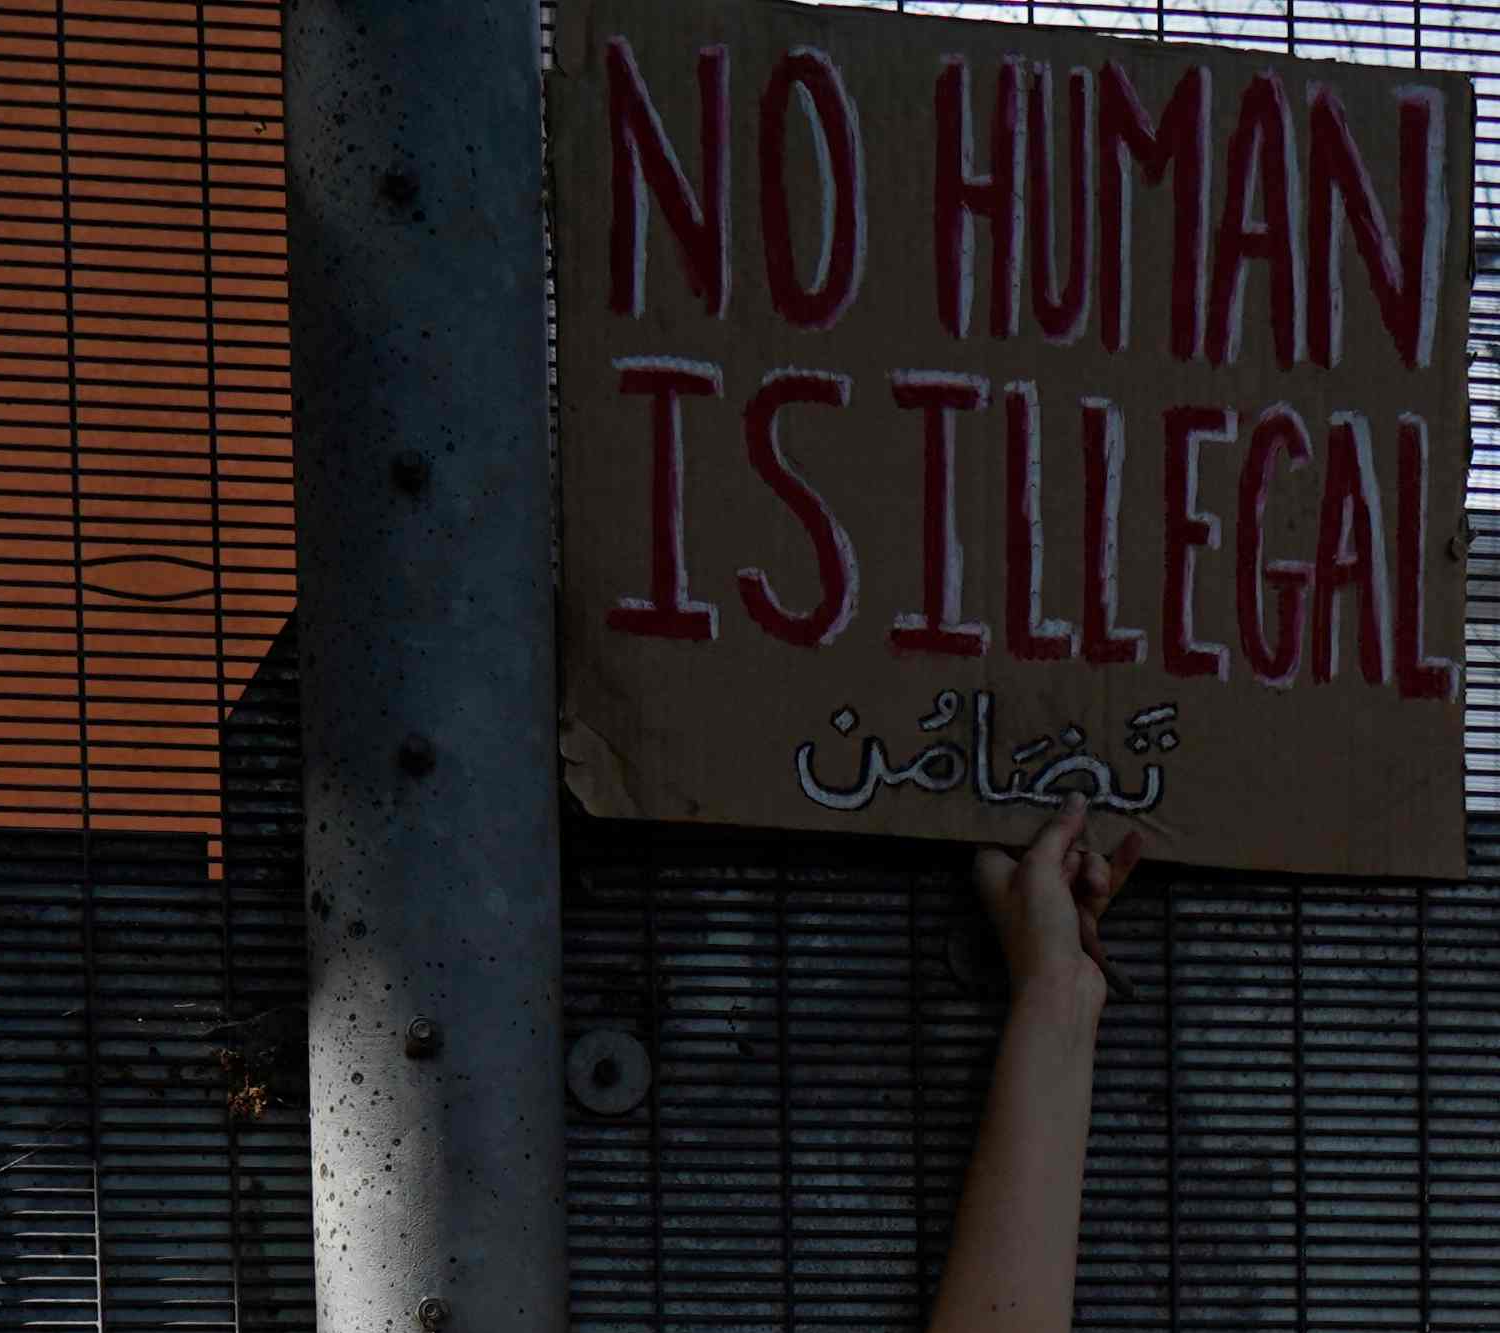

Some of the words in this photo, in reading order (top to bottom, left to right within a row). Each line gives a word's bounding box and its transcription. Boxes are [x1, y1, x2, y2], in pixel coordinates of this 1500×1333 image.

[607, 35, 867, 331] NO
[935, 52, 1449, 371] HUMAN
[607, 353, 859, 648] IS
[886, 368, 1458, 704] ILLEGAL
